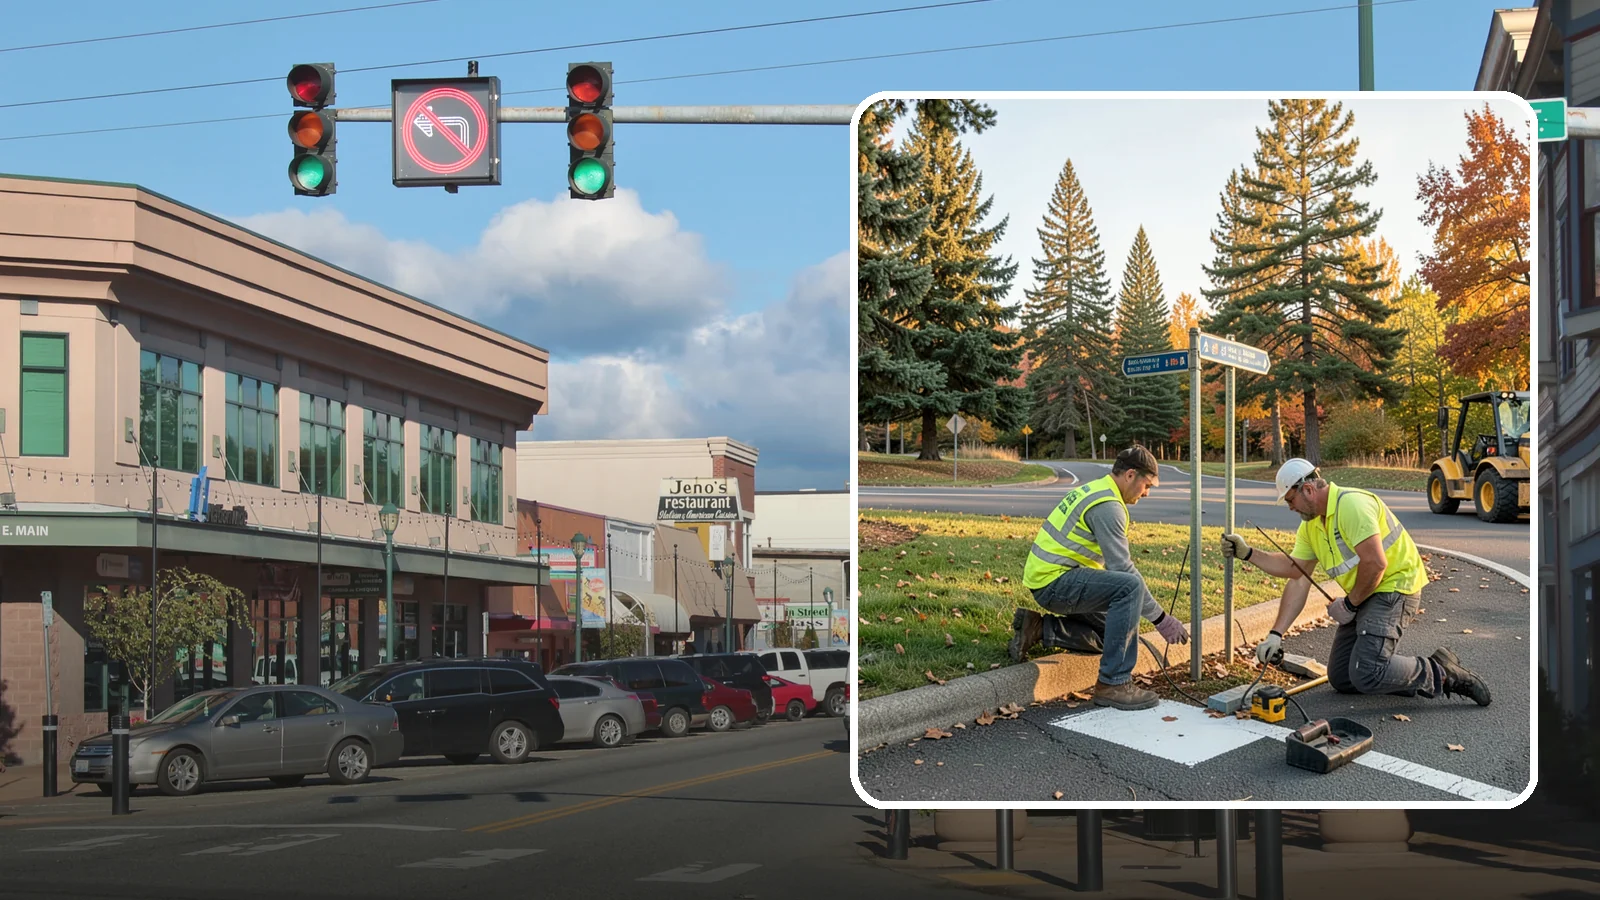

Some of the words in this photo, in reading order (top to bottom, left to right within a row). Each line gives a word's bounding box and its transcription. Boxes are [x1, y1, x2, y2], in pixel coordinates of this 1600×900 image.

[670, 480, 727, 494] Jeno's
[665, 496, 731, 508] restaurant
[658, 510, 681, 519] Italian
[686, 510, 714, 519] American
[715, 510, 738, 519] Cuisine
[2, 525, 13, 536] E.
[15, 525, 49, 536] MAIN
[797, 608, 828, 616] Street
